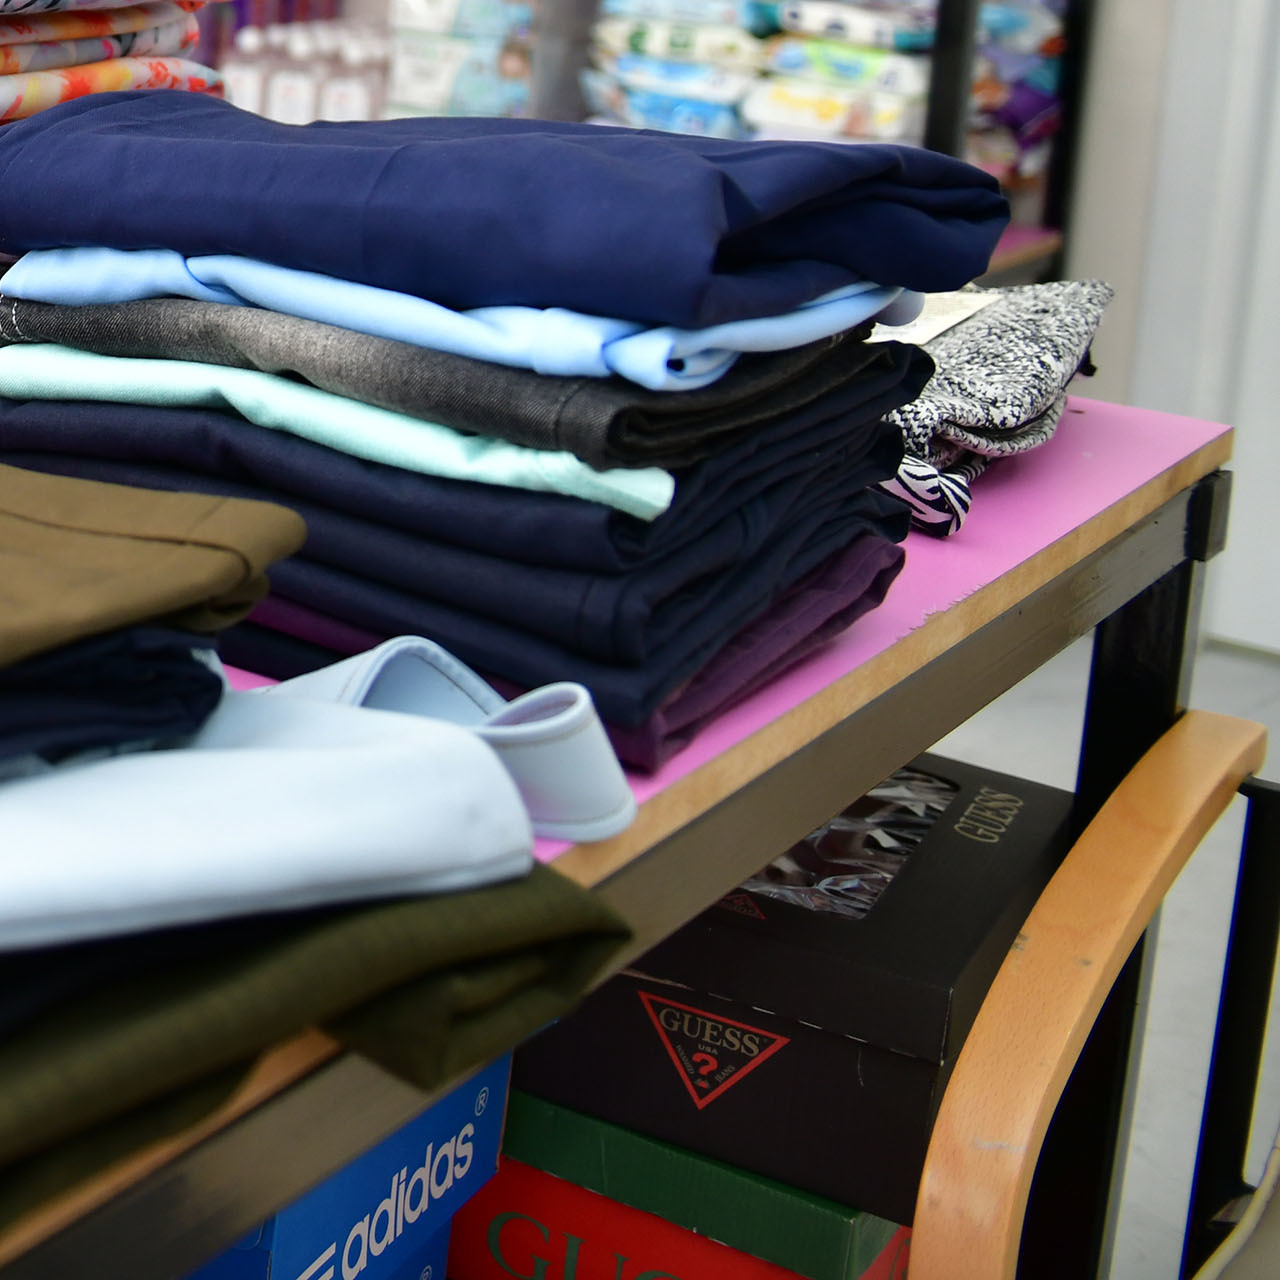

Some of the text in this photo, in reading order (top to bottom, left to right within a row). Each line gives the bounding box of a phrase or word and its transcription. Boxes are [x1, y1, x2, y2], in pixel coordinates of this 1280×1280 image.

[953, 786, 1024, 843] GUESS
[658, 1007, 761, 1057] GUESS
[342, 1122, 475, 1280] adidas
